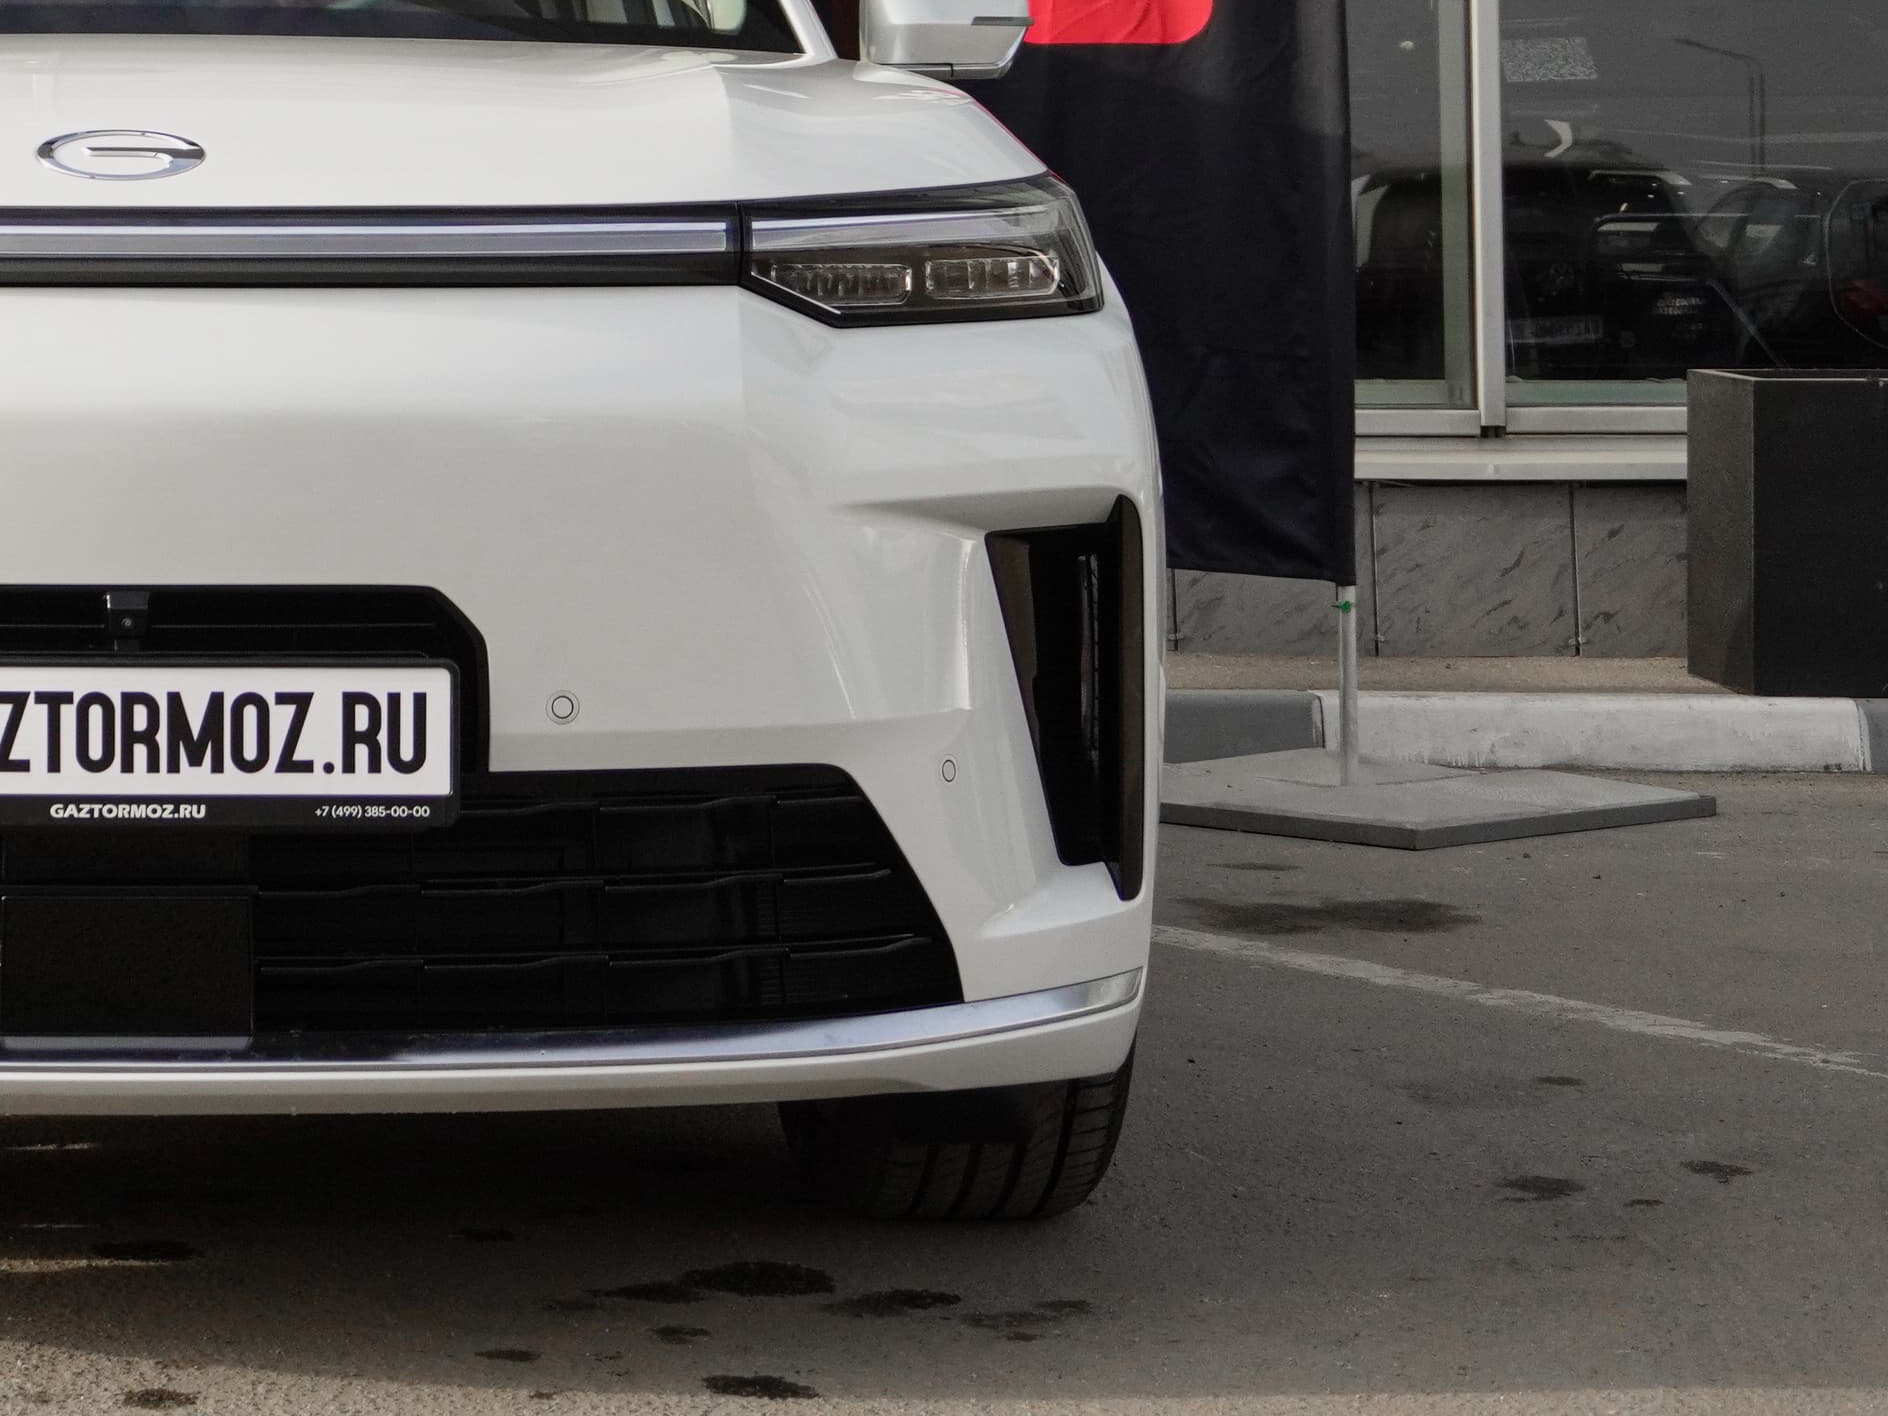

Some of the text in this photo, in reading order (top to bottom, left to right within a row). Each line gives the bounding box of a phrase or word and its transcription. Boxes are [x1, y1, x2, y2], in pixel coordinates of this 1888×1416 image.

[49, 803, 207, 819] GAZTORMOZ.RU
[314, 804, 431, 819] +7 (499) 385-00-00
